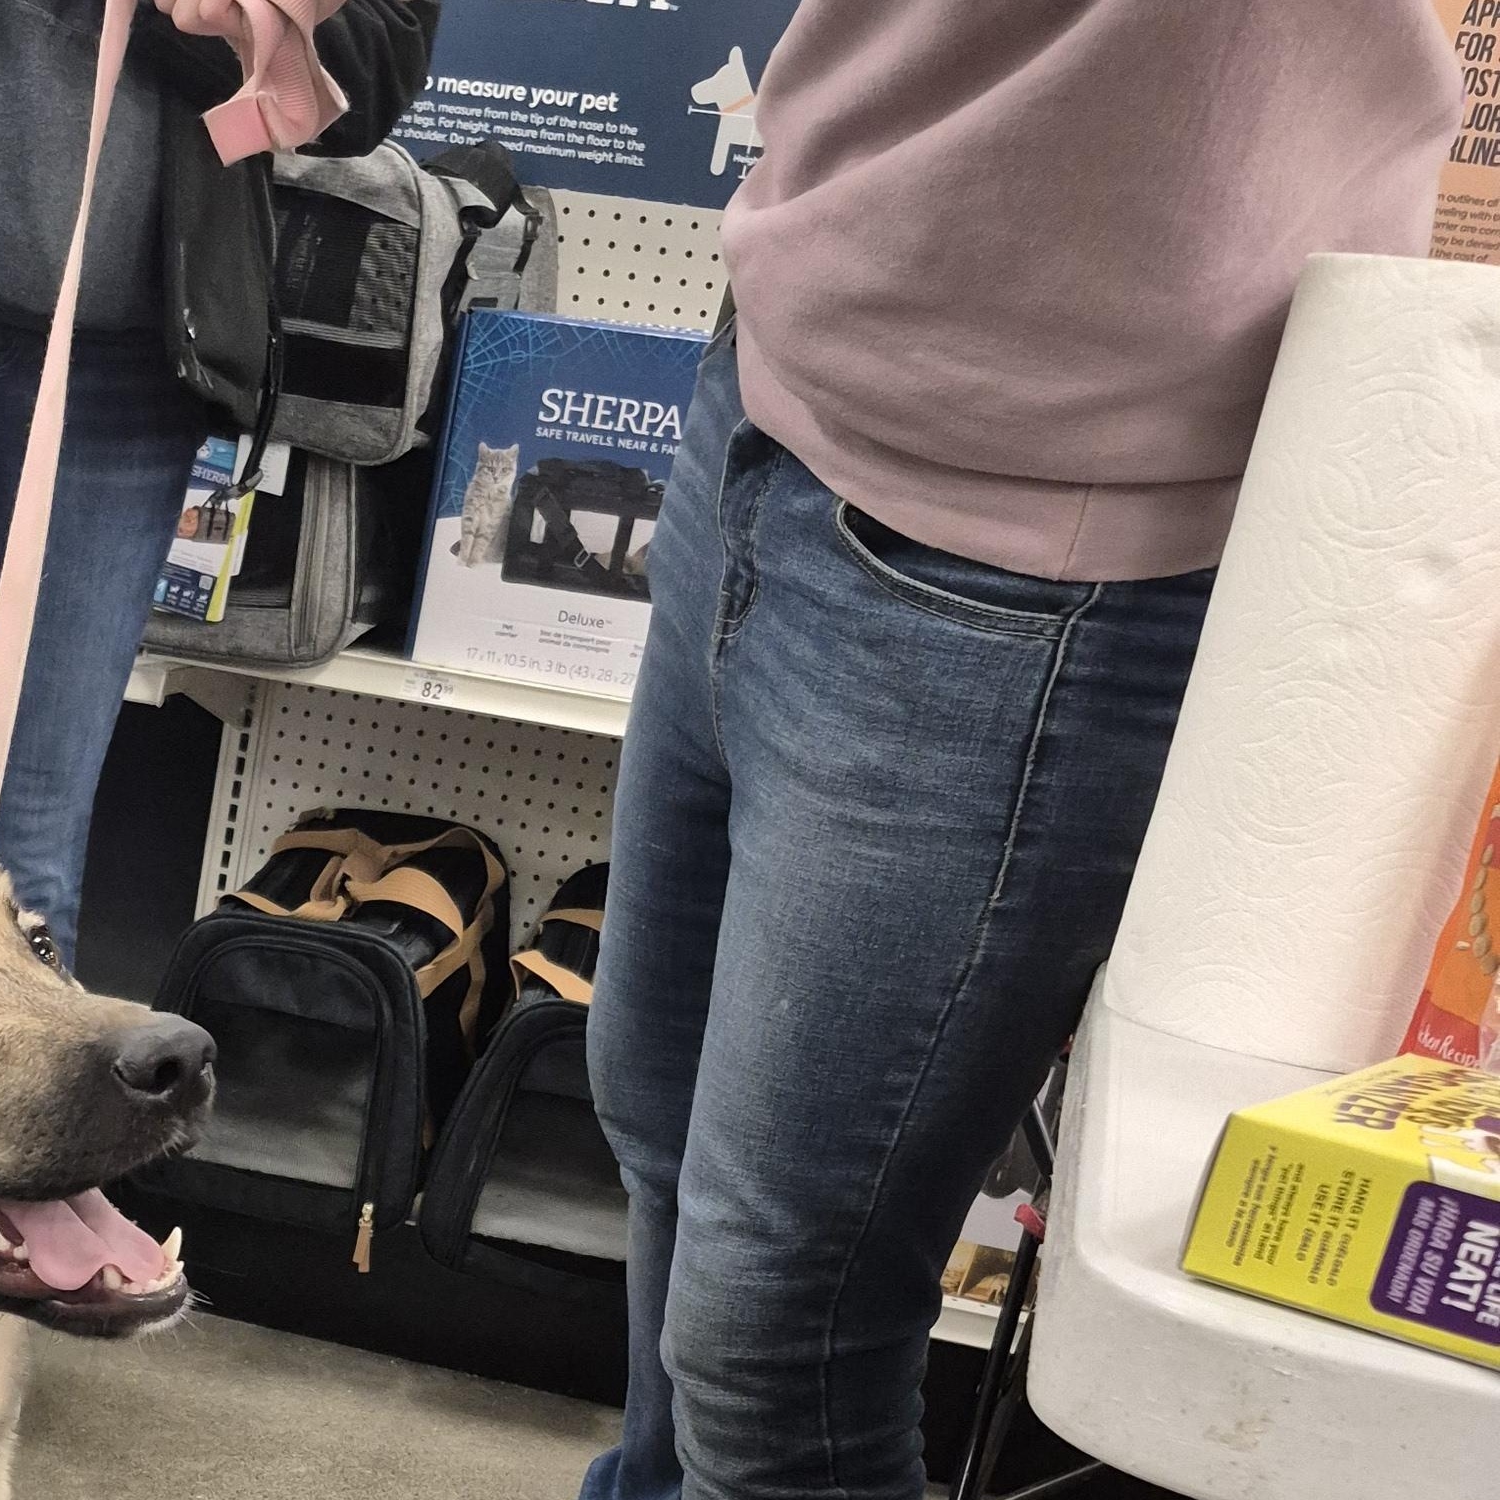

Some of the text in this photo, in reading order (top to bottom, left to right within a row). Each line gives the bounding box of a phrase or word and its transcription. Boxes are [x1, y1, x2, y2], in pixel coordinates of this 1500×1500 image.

[1455, 31, 1496, 63] FOR
[437, 77, 527, 101] measure
[528, 86, 579, 108] your
[579, 91, 620, 114] pet
[1461, 67, 1500, 98] OST
[438, 104, 638, 135] measure from the tip of the nose to the
[438, 117, 455, 128] For
[493, 125, 538, 139] measure
[540, 128, 565, 141] from
[567, 132, 585, 144] the
[586, 134, 612, 147] floor
[613, 138, 625, 149] to
[627, 140, 645, 151] the
[450, 132, 465, 144] Do
[524, 143, 576, 158] maximum
[577, 150, 613, 164] weight
[538, 388, 682, 440] SHERPA
[535, 427, 563, 439] SAFE
[617, 438, 647, 451] NEAR
[649, 443, 658, 453] &
[544, 659, 553, 672] 3
[555, 661, 567, 675] lb
[421, 681, 443, 700] 82
[1312, 1183, 1332, 1211] USE
[1330, 1169, 1356, 1214] STORE
[1345, 1177, 1373, 1231] HANG IT
[1307, 1212, 1322, 1226] IT
[1326, 1216, 1340, 1229] IT
[1420, 1250, 1445, 1278] SU
[1440, 1219, 1500, 1312] NEAT!
[1405, 1276, 1436, 1315] VIDA
